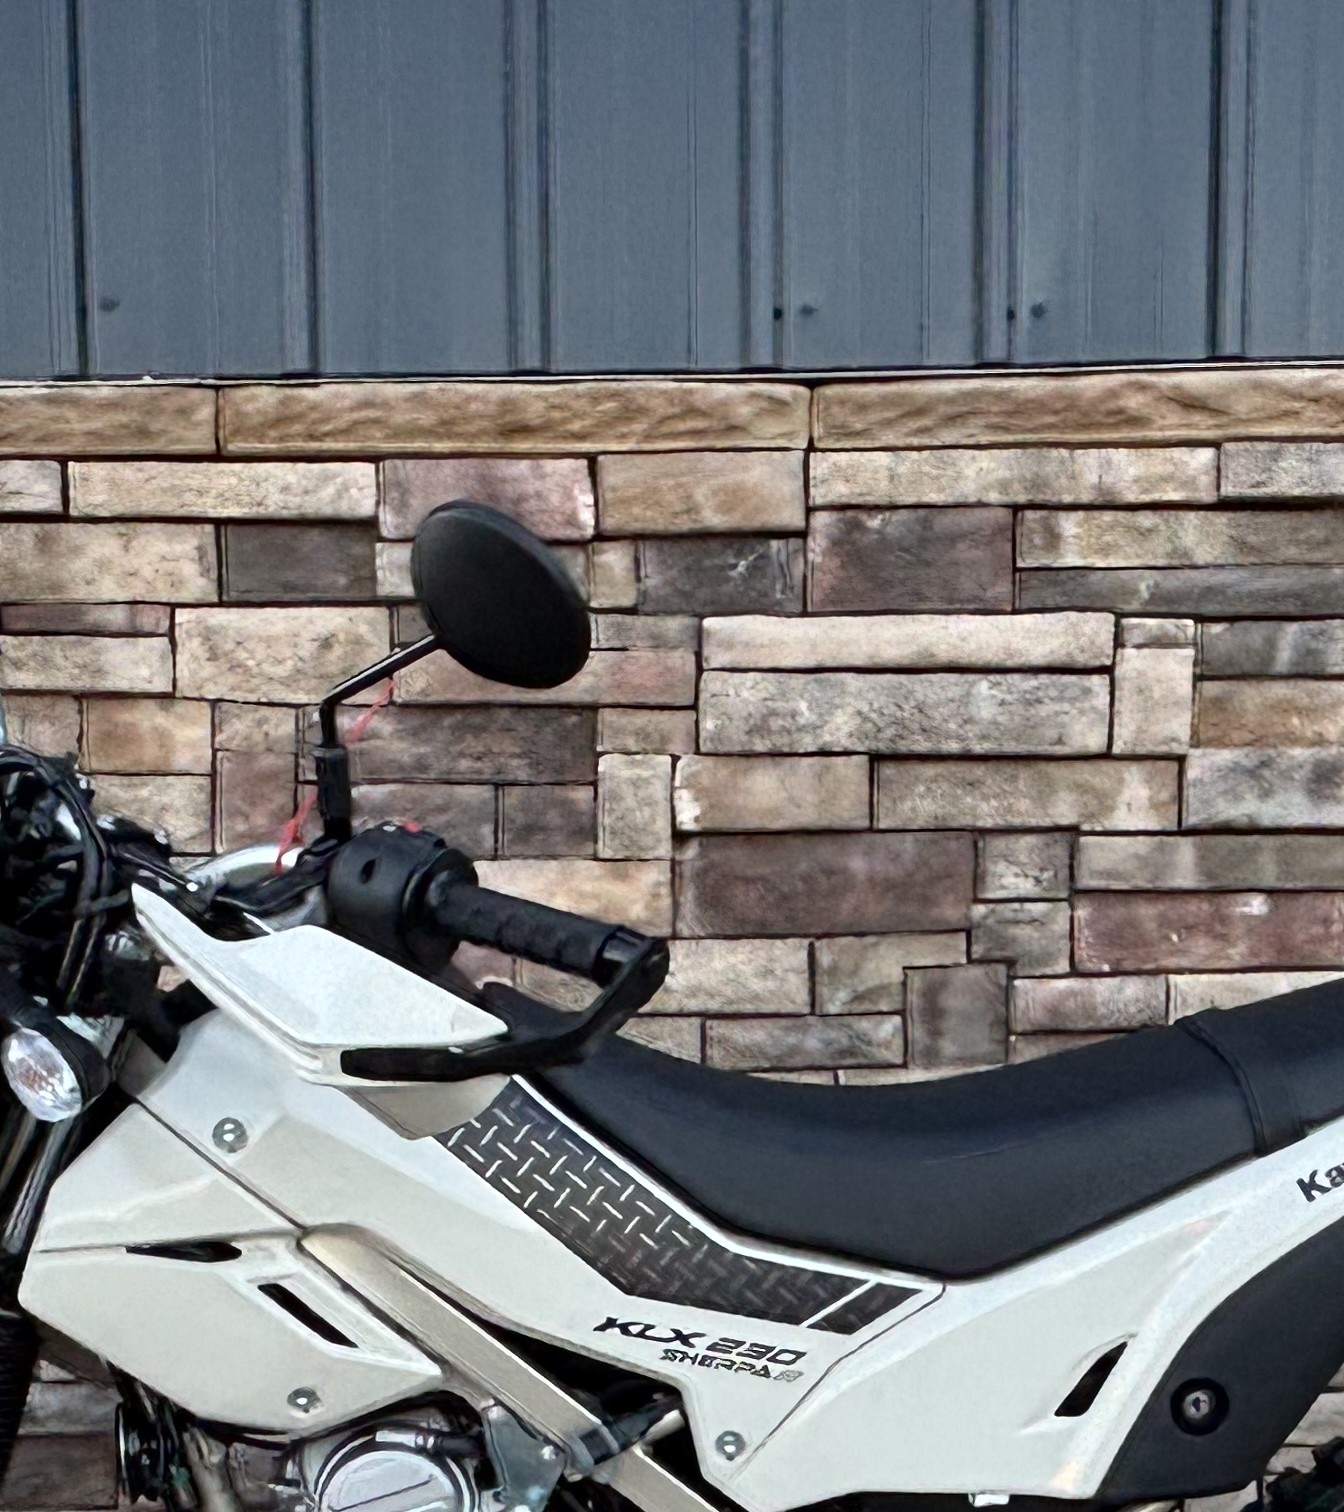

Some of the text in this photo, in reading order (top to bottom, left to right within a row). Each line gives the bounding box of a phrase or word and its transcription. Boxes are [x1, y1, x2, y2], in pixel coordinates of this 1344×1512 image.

[592, 1316, 808, 1366] KLX 230
[658, 1348, 772, 1379] SHERPA
